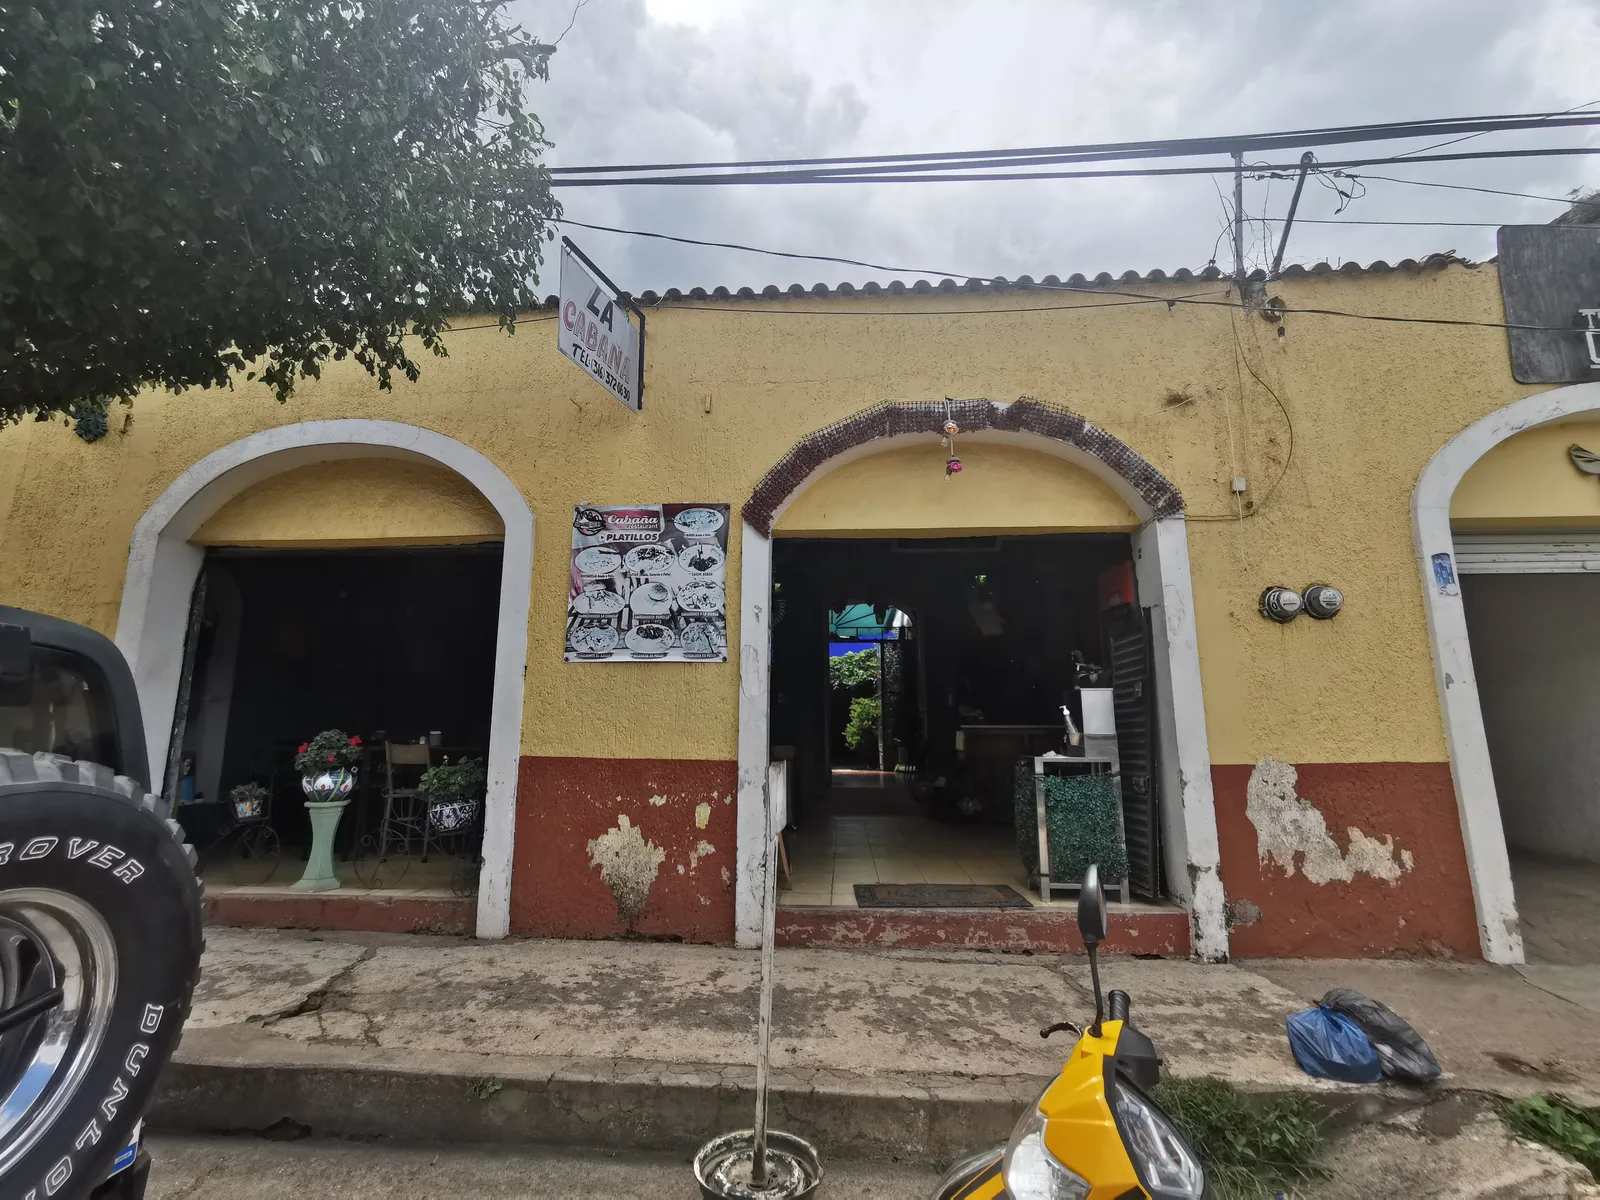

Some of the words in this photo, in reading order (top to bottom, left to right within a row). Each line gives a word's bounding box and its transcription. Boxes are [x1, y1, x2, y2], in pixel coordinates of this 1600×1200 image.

[586, 286, 613, 333] LA
[607, 514, 659, 524] Cabaña
[606, 533, 658, 541] PLATILLOS
[25, 1003, 164, 1200] DUNLO
